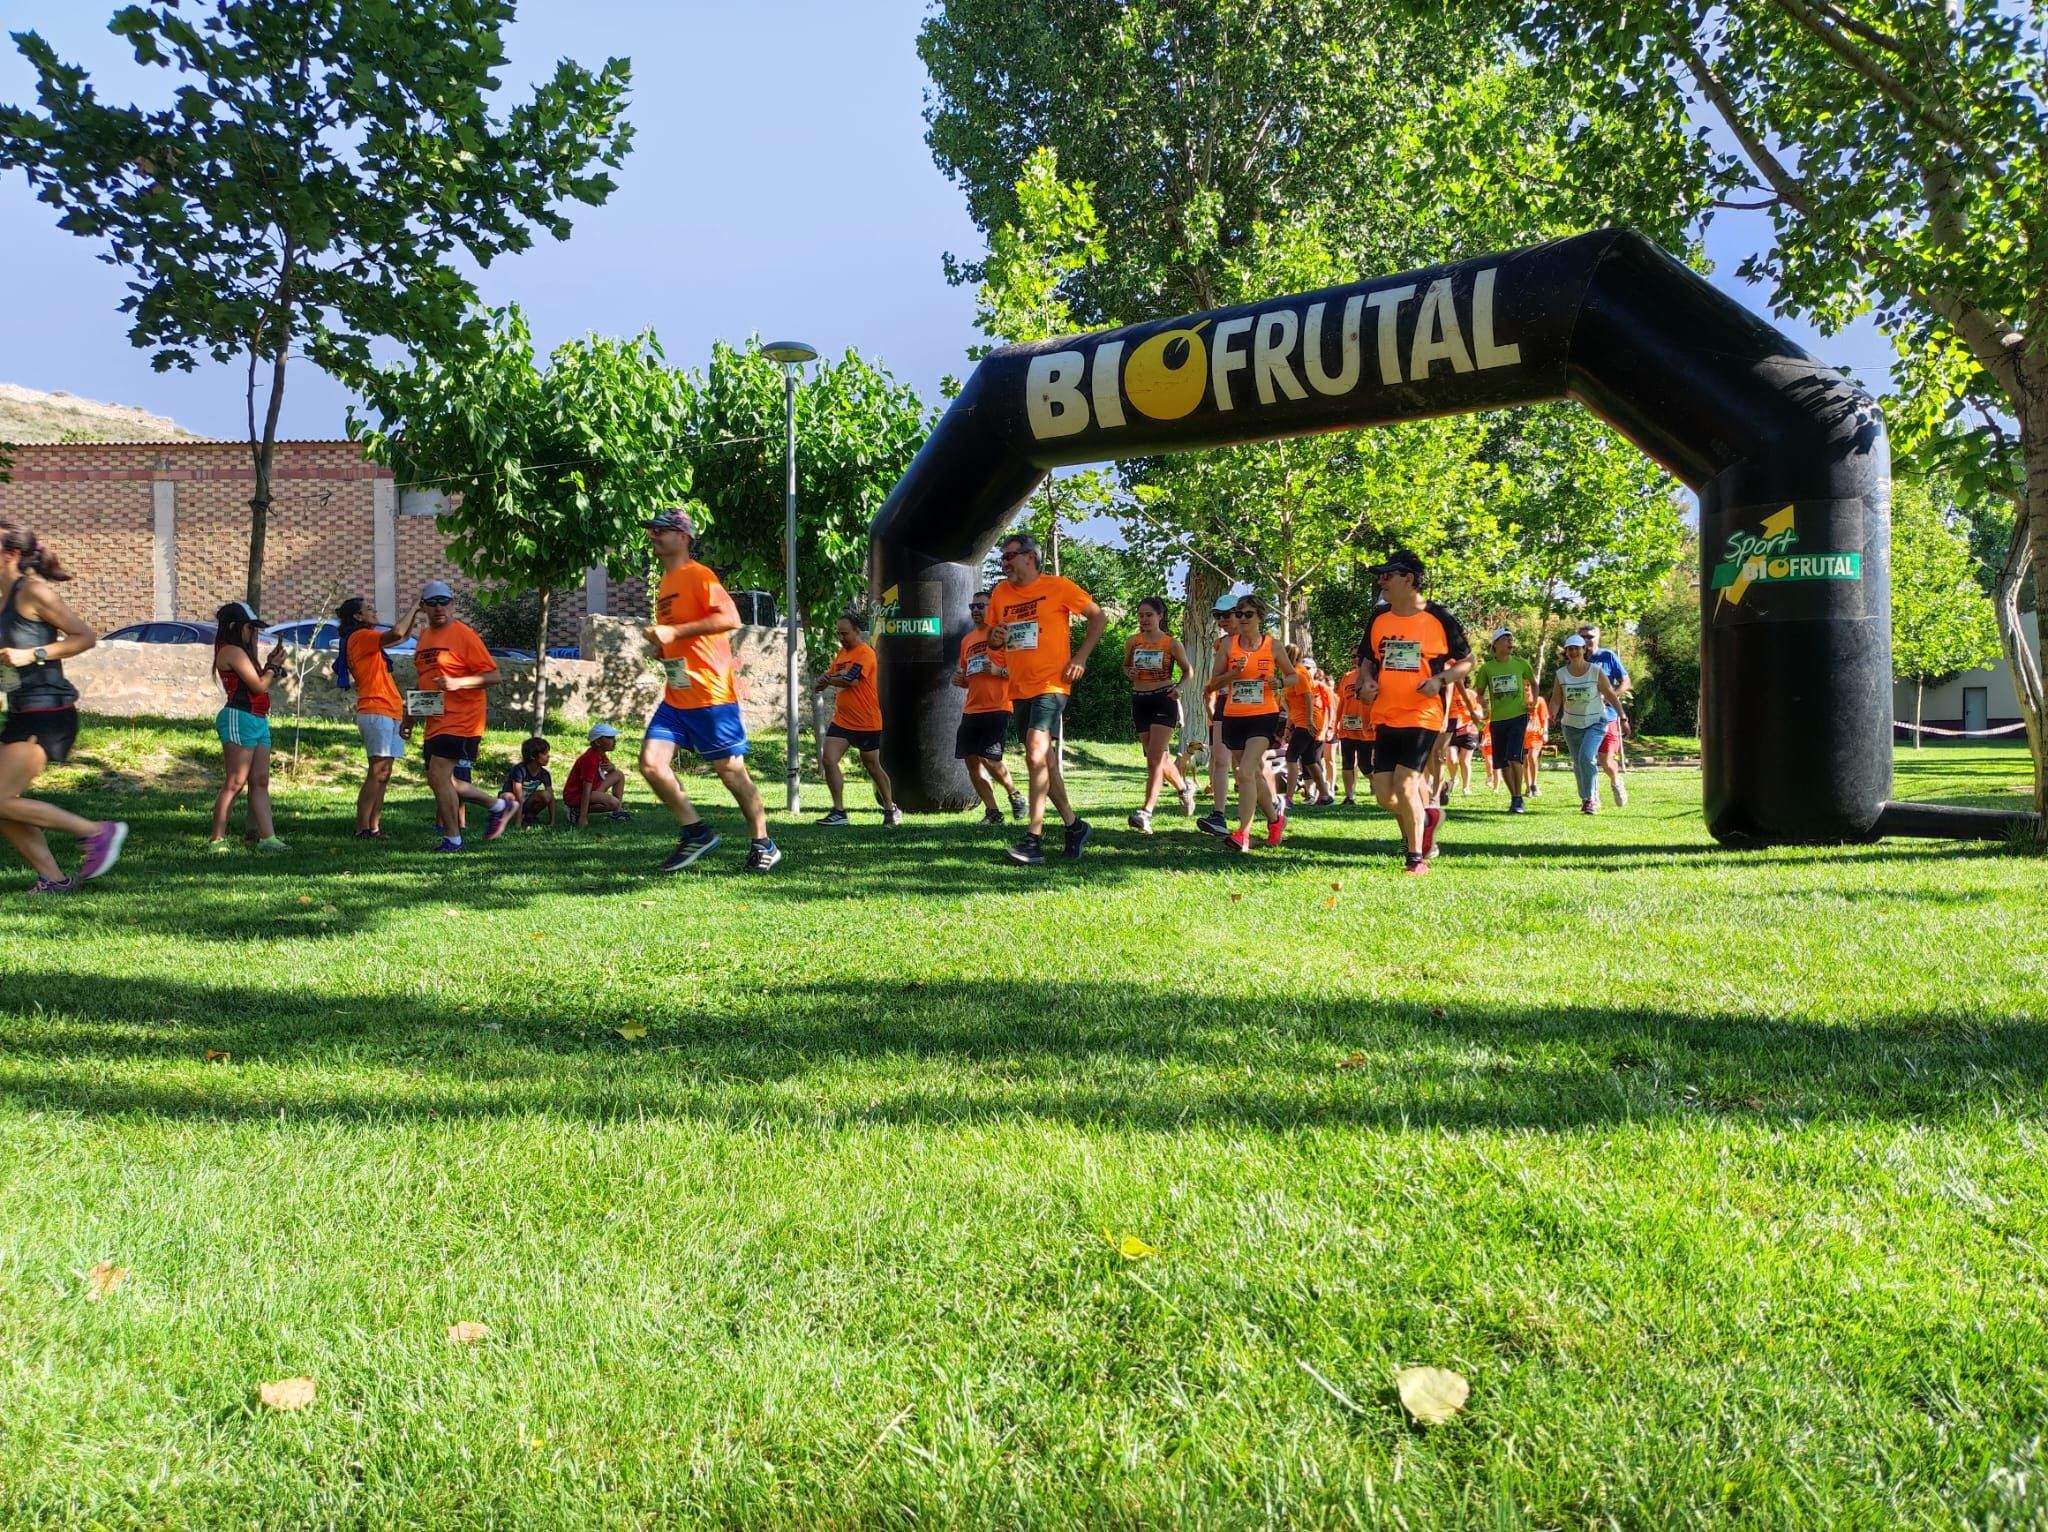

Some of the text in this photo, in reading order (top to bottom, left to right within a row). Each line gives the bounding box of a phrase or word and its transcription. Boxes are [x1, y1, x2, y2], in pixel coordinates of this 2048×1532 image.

[1026, 267, 1521, 440] BIOFRUTAL
[1725, 529, 1797, 567] Sport
[1743, 556, 1854, 581] BIOFRUTAL
